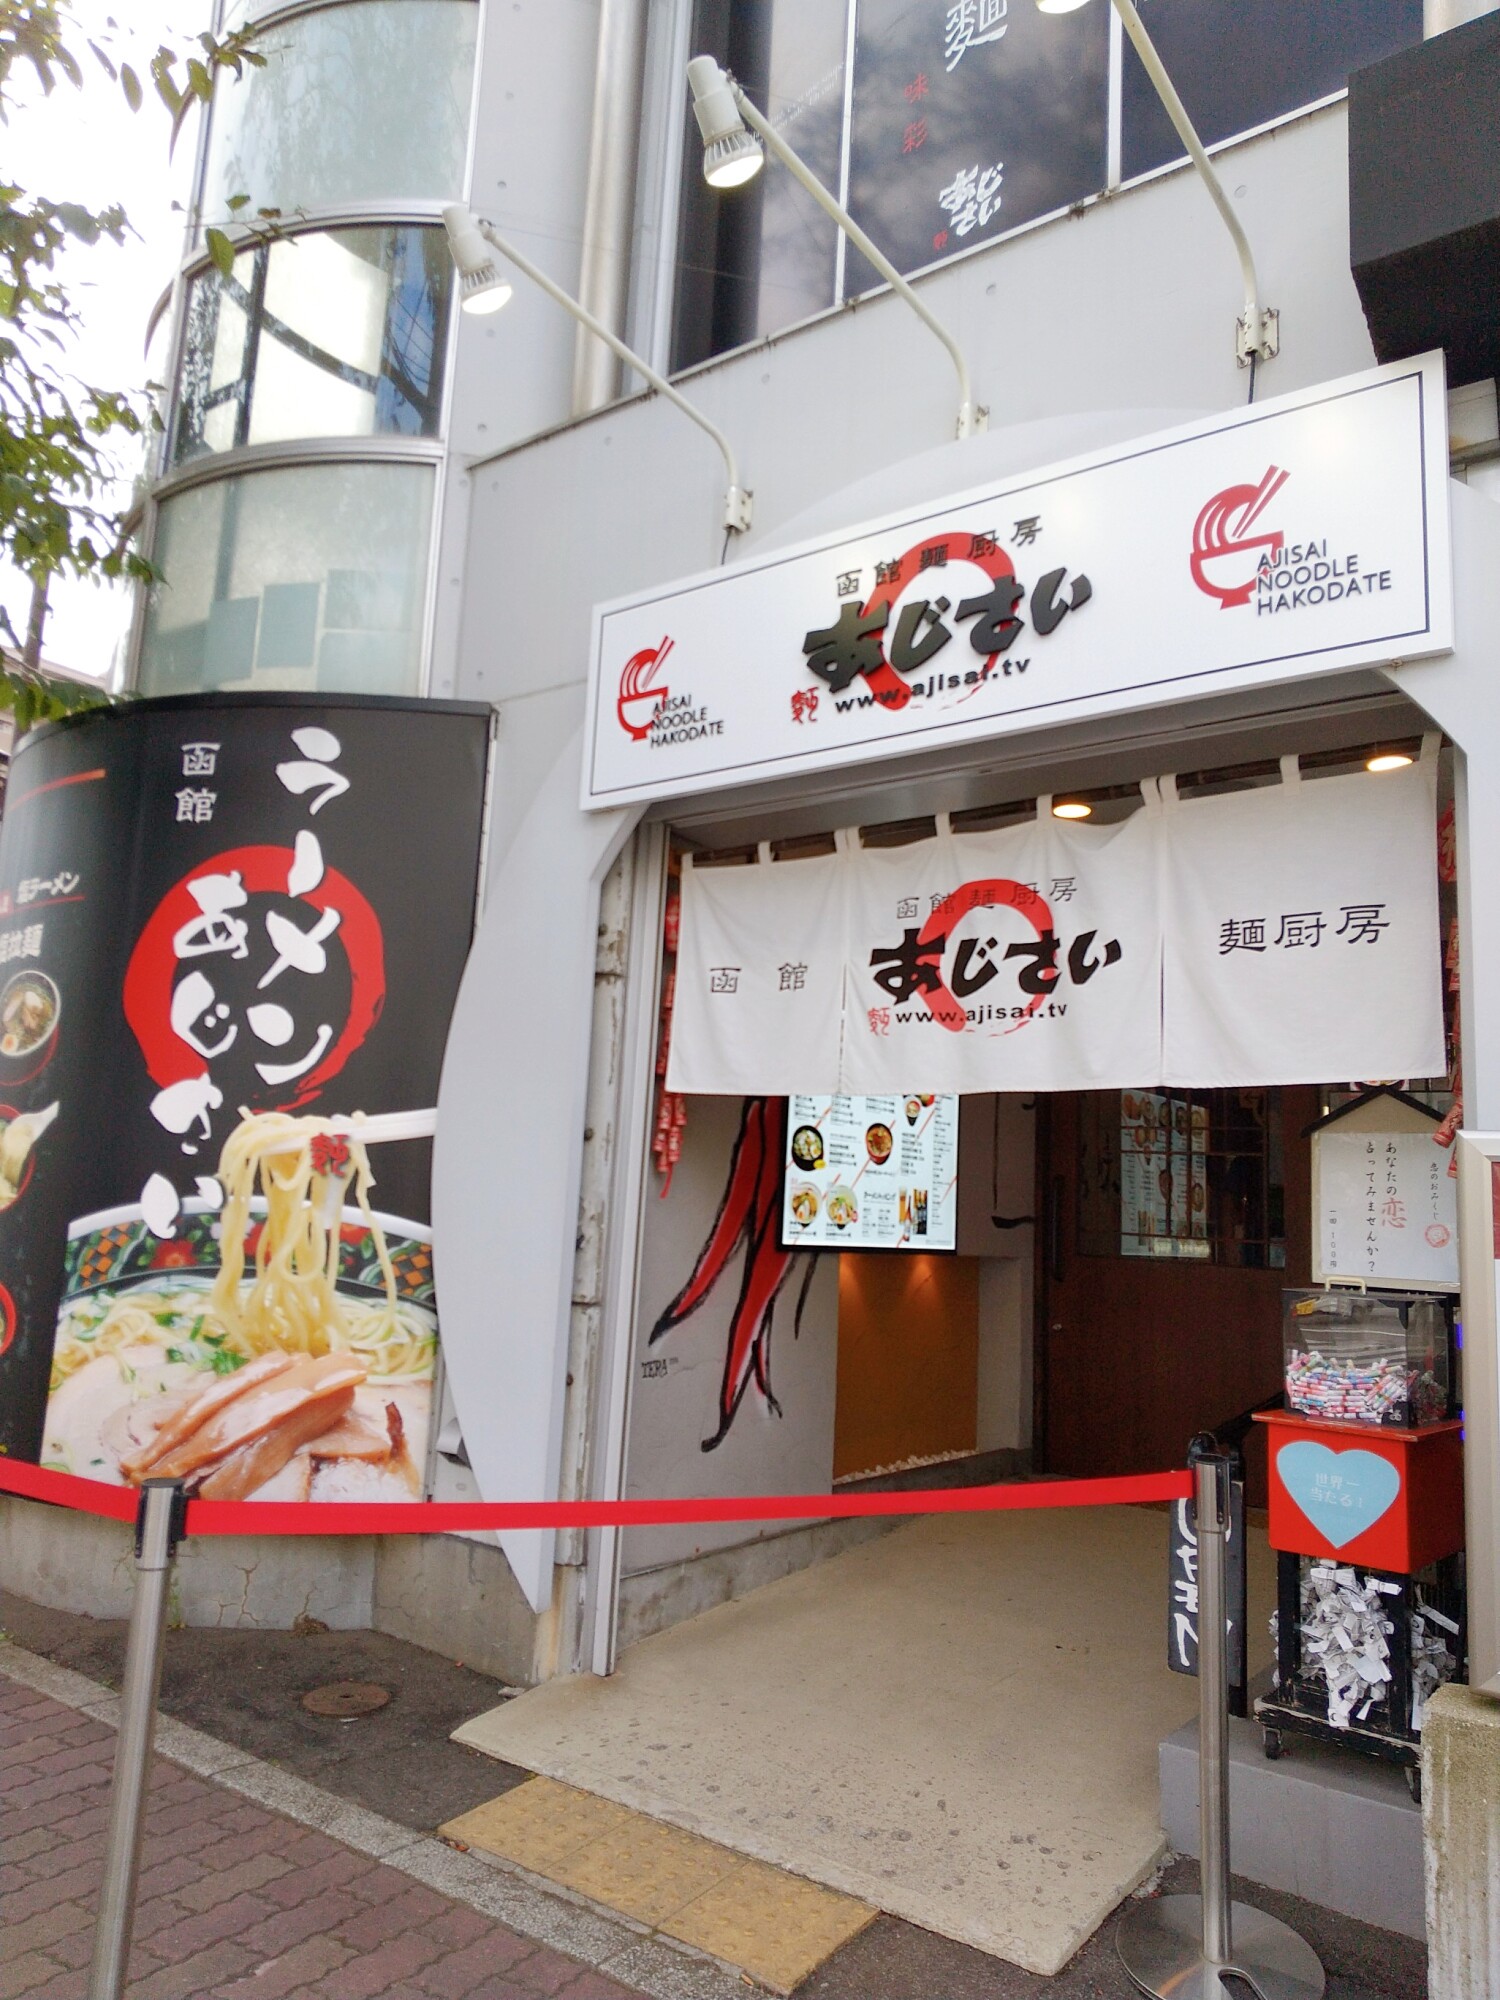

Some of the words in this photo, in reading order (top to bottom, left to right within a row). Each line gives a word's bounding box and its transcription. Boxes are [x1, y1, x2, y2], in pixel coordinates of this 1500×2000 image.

[1257, 539, 1327, 571] AJISAI
[1257, 554, 1359, 593] NOODLE
[1257, 570, 1392, 616] HAKODATE
[802, 567, 1093, 693] あじさい
[835, 657, 1032, 713] www.ajisai.tv
[651, 707, 708, 731] NOODLE
[652, 694, 692, 716] AJISAI
[650, 720, 724, 748] HAKODATE
[175, 742, 222, 823] 函館
[1218, 903, 1391, 955] 麺厨房
[709, 961, 809, 994] 函館
[868, 928, 1123, 1004] あじさい
[895, 1002, 1068, 1025] www.ajisai.tv
[1315, 1473, 1360, 1490] 世界一
